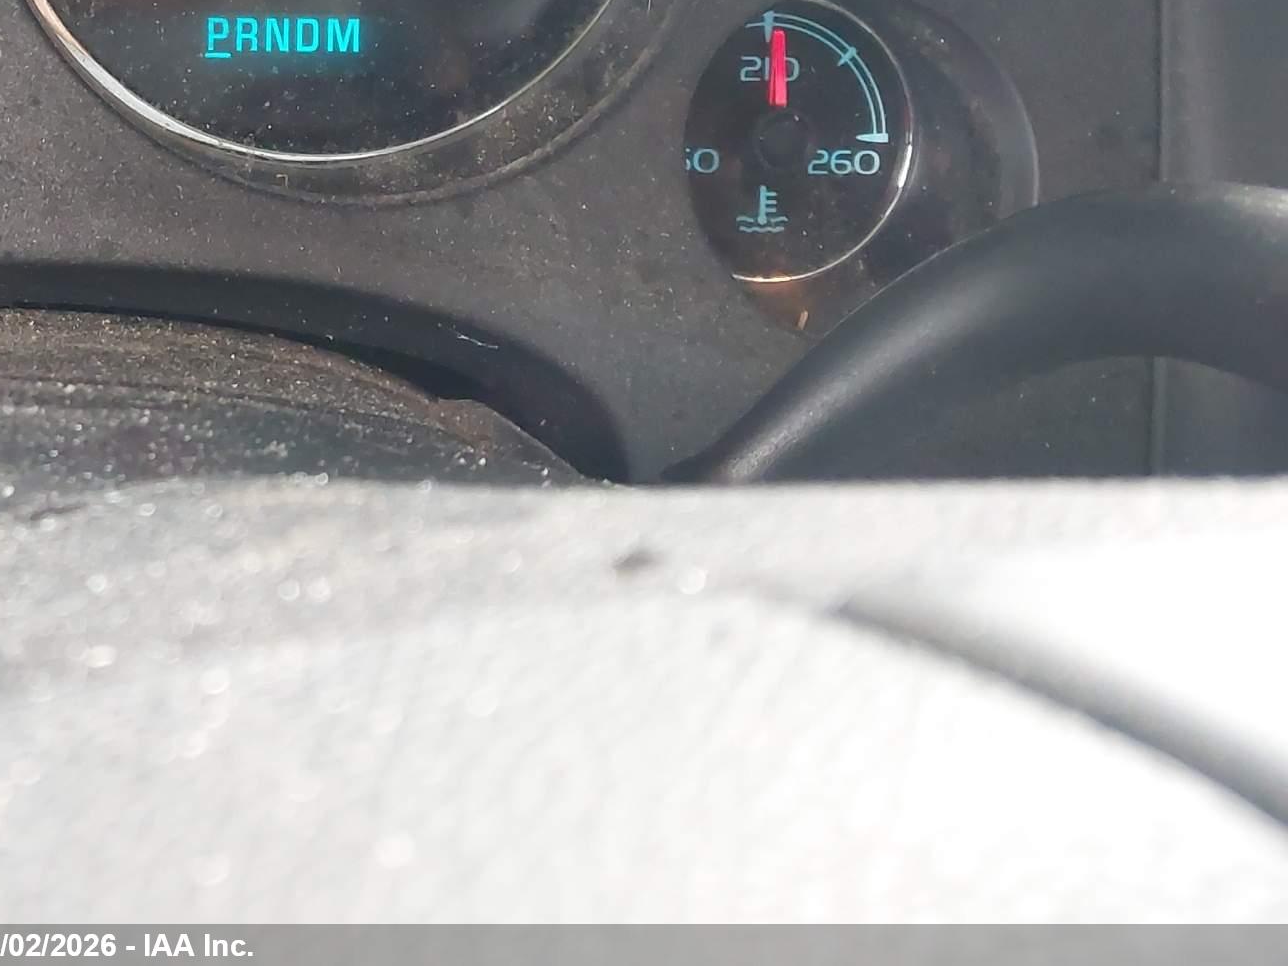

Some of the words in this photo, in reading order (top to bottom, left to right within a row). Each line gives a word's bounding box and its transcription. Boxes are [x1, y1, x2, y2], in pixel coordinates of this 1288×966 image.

[207, 17, 360, 52] PRNDM
[685, 148, 720, 173] 0
[808, 150, 880, 174] 260
